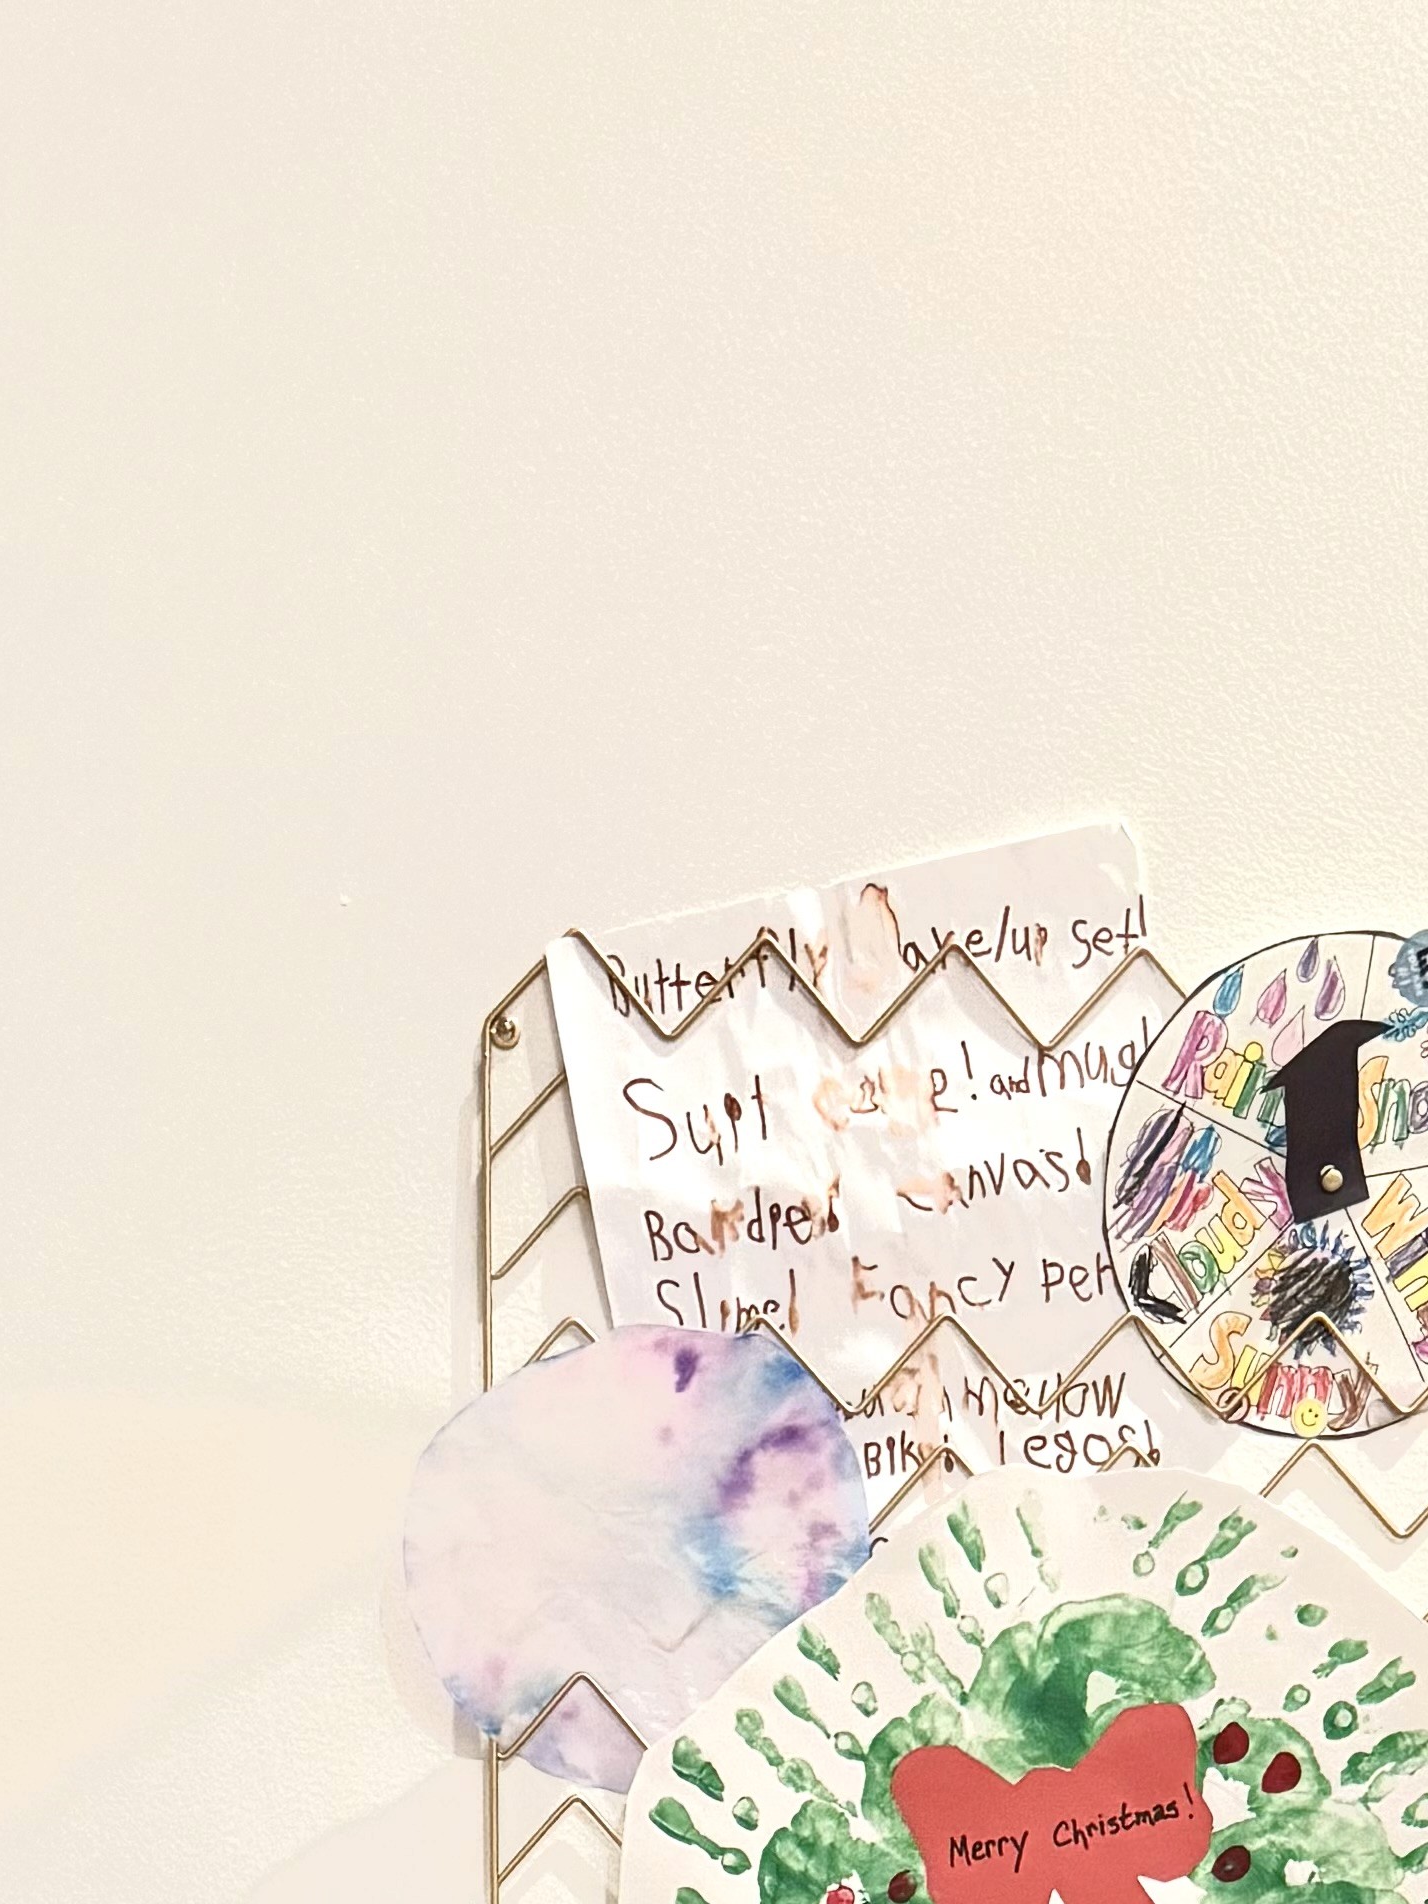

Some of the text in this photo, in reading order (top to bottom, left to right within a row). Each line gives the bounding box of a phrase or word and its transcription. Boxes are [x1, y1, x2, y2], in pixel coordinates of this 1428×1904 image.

[1128, 1156, 1295, 1325] Cloudy
[1189, 1310, 1374, 1432] Sunny
[949, 1781, 1195, 1873] Merry Christmas!
